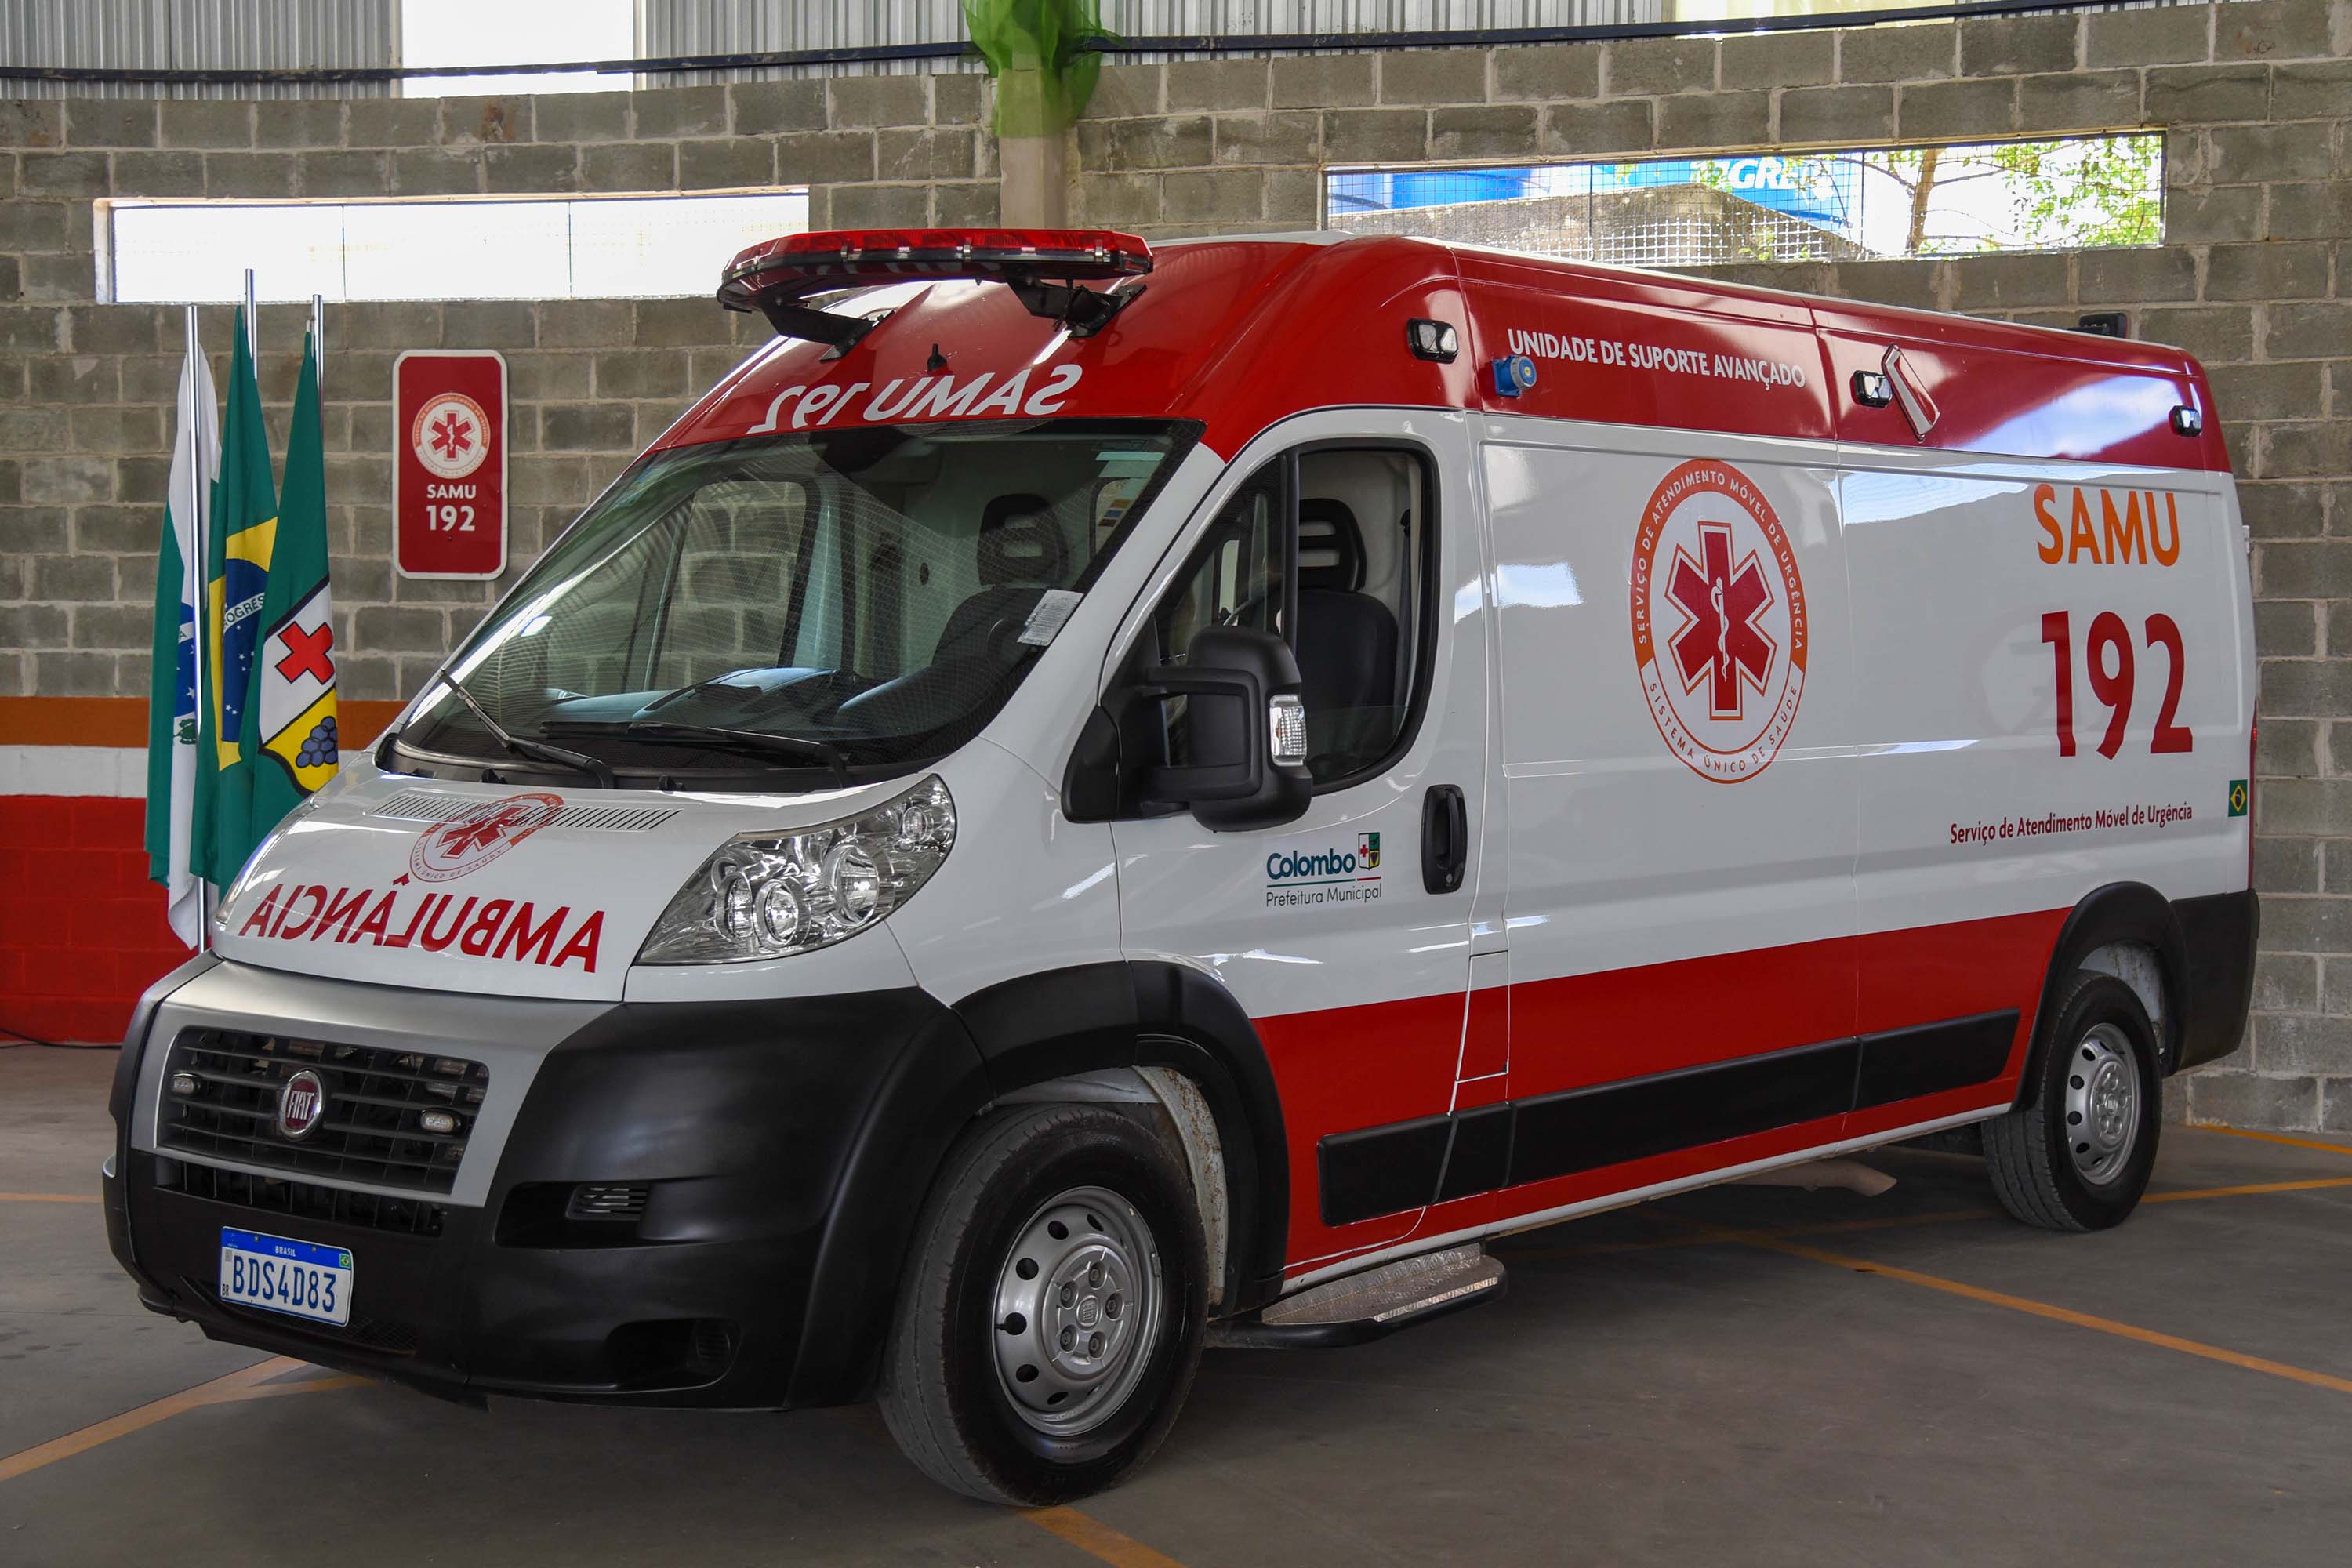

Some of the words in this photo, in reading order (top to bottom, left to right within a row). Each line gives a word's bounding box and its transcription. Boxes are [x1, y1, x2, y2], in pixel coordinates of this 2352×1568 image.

[1508, 328, 1598, 364] UNIDADE
[1599, 339, 1627, 366] DE
[1628, 344, 1710, 376] SUPORTE
[1713, 355, 1806, 390] AVANÇADO
[426, 484, 477, 499] SAMU
[426, 505, 476, 532] 192
[2034, 483, 2180, 568] SAMU
[1636, 557, 1648, 644] SERVIÇO
[1642, 526, 1654, 551] DE
[1652, 470, 1726, 524] ATENDIMENTO
[1730, 477, 1766, 522] MÓVEL
[1768, 522, 1782, 546] DE
[1780, 550, 1803, 650] URGÊNCIA
[223, 593, 264, 626] OGRES
[2041, 609, 2194, 760] 192
[1650, 683, 1694, 759] SISTEMA
[1704, 754, 1746, 773] ÚNICO
[1751, 746, 1766, 764] DE
[1769, 686, 1798, 745] SAÚDE
[1950, 820, 1996, 846] Serviço
[1998, 817, 2014, 839] de
[2016, 811, 2092, 837] Atendimento
[2095, 804, 2129, 829] Móvel
[2132, 804, 2146, 825] de
[2147, 801, 2193, 829] Urgência
[1266, 848, 1356, 880] Colombo
[1266, 890, 1323, 907] Prefeitura
[1327, 883, 1381, 903] Municipal
[287, 1090, 314, 1120] FIAT
[275, 1245, 296, 1257] BRASIL
[233, 1255, 336, 1312] BDS4D83
